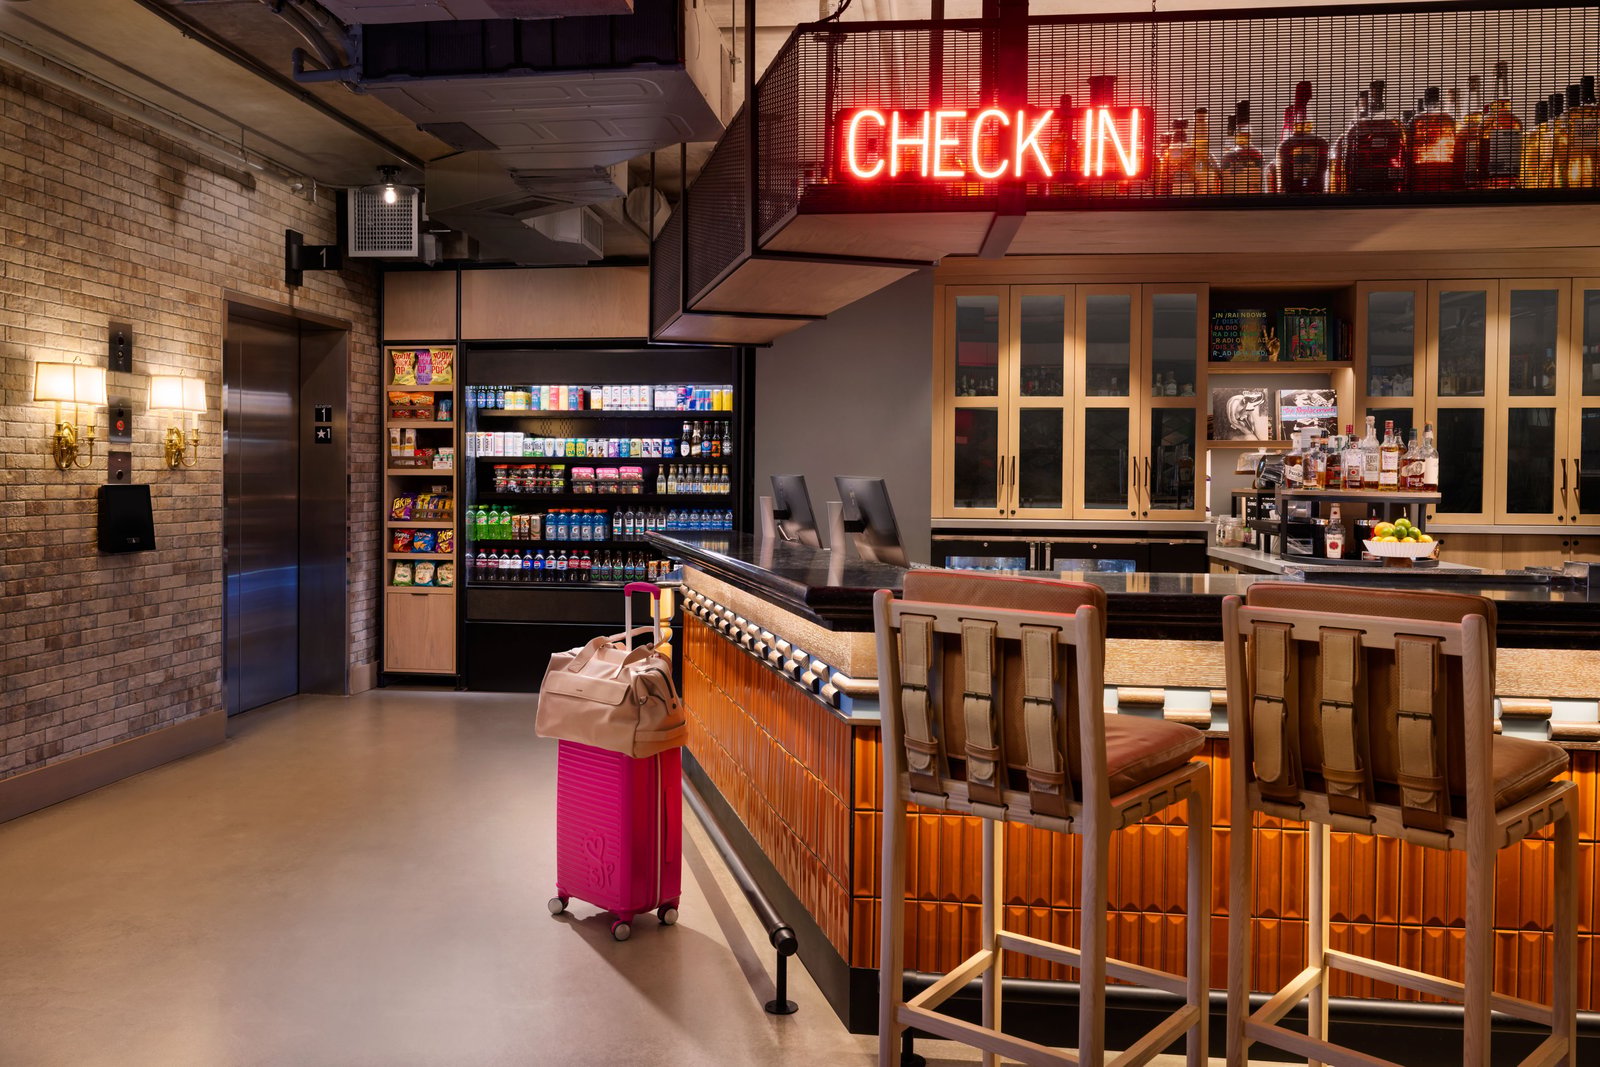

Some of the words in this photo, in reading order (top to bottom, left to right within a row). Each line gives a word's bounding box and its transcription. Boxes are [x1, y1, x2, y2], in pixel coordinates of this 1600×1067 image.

[847, 109, 1053, 178] CHECK
[1083, 108, 1139, 176] IN
[319, 247, 327, 268] 1
[431, 366, 445, 374] POP
[321, 408, 326, 422] 1
[326, 428, 331, 439] 1
